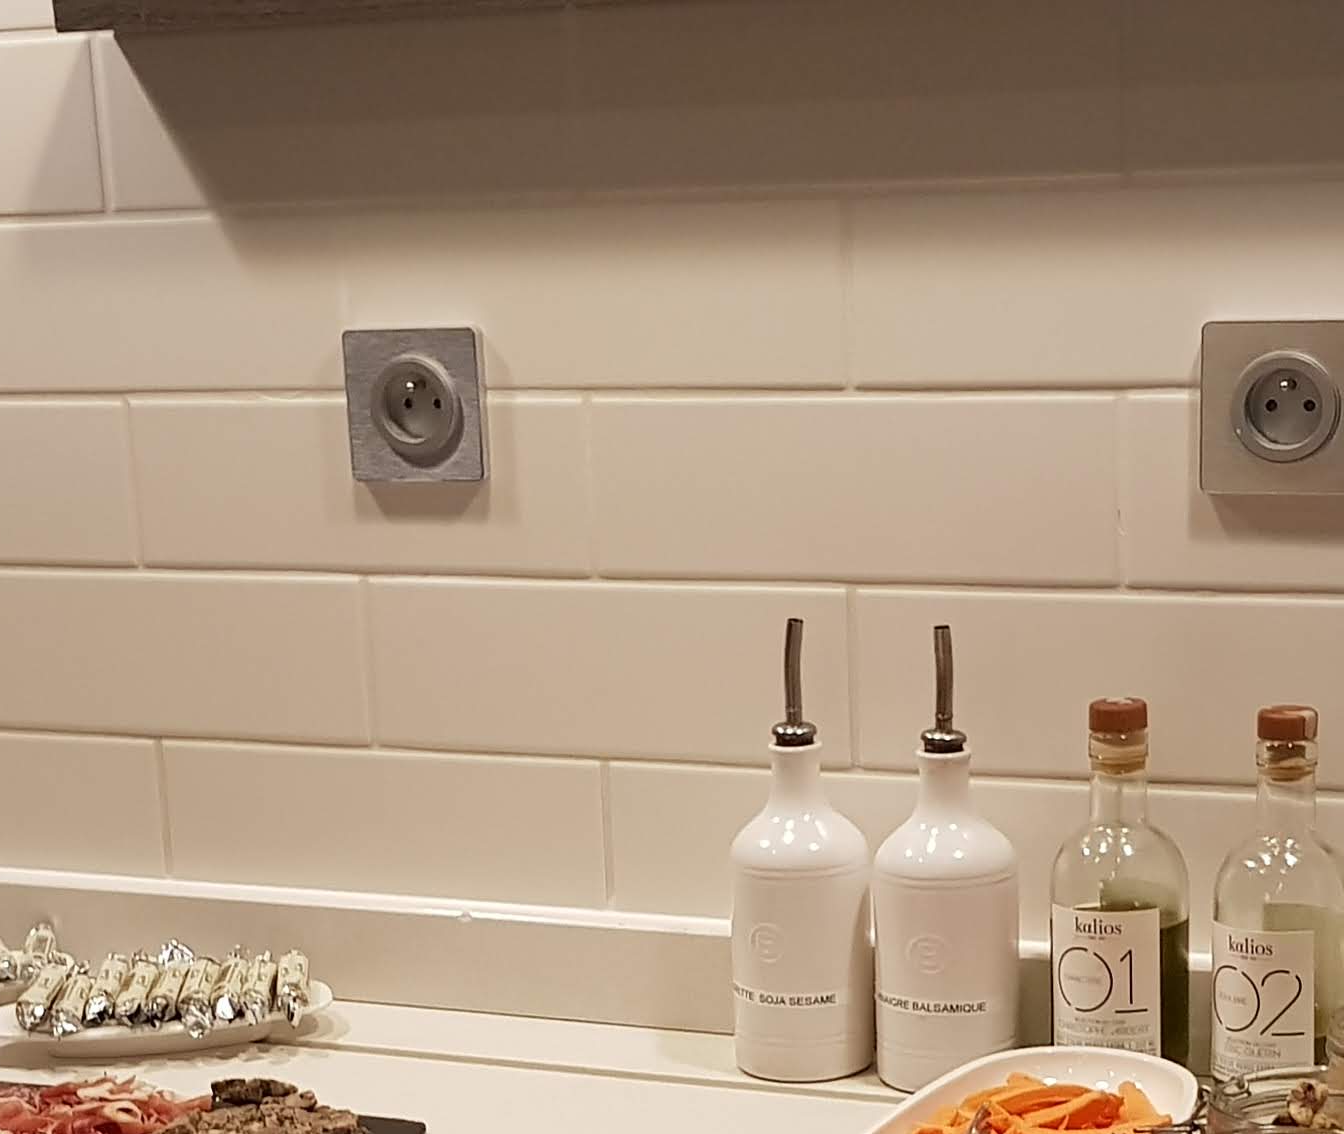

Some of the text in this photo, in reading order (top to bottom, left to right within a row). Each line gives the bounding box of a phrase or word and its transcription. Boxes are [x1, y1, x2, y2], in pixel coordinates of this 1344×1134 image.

[1074, 916, 1122, 935] kalios
[1228, 934, 1274, 956] kalios
[759, 993, 787, 1006] SOJA
[789, 993, 837, 1006] SESAME
[912, 1001, 987, 1014] BALSAMIQUE
